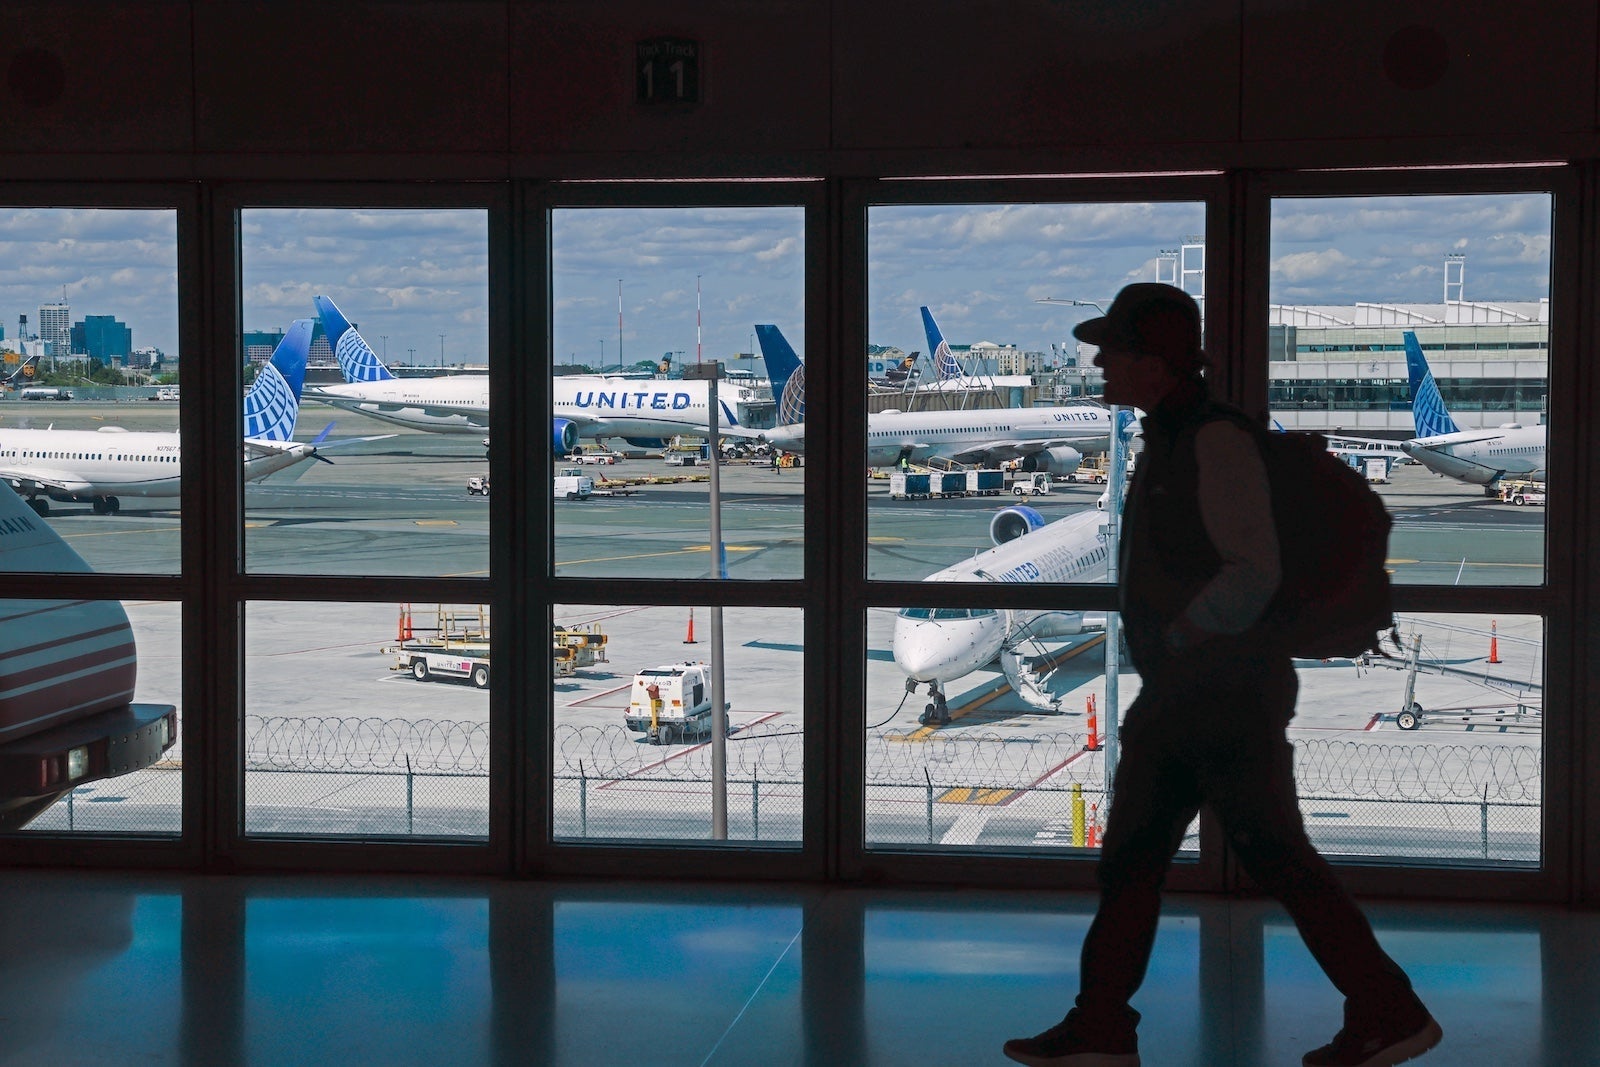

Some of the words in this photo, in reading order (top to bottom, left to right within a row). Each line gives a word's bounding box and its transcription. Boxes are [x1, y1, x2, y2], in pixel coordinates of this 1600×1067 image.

[663, 41, 695, 57] Track
[669, 60, 684, 97] 1
[574, 391, 691, 410] UNITED
[1053, 412, 1098, 422] UNITED
[1034, 545, 1074, 573] EXPRESS
